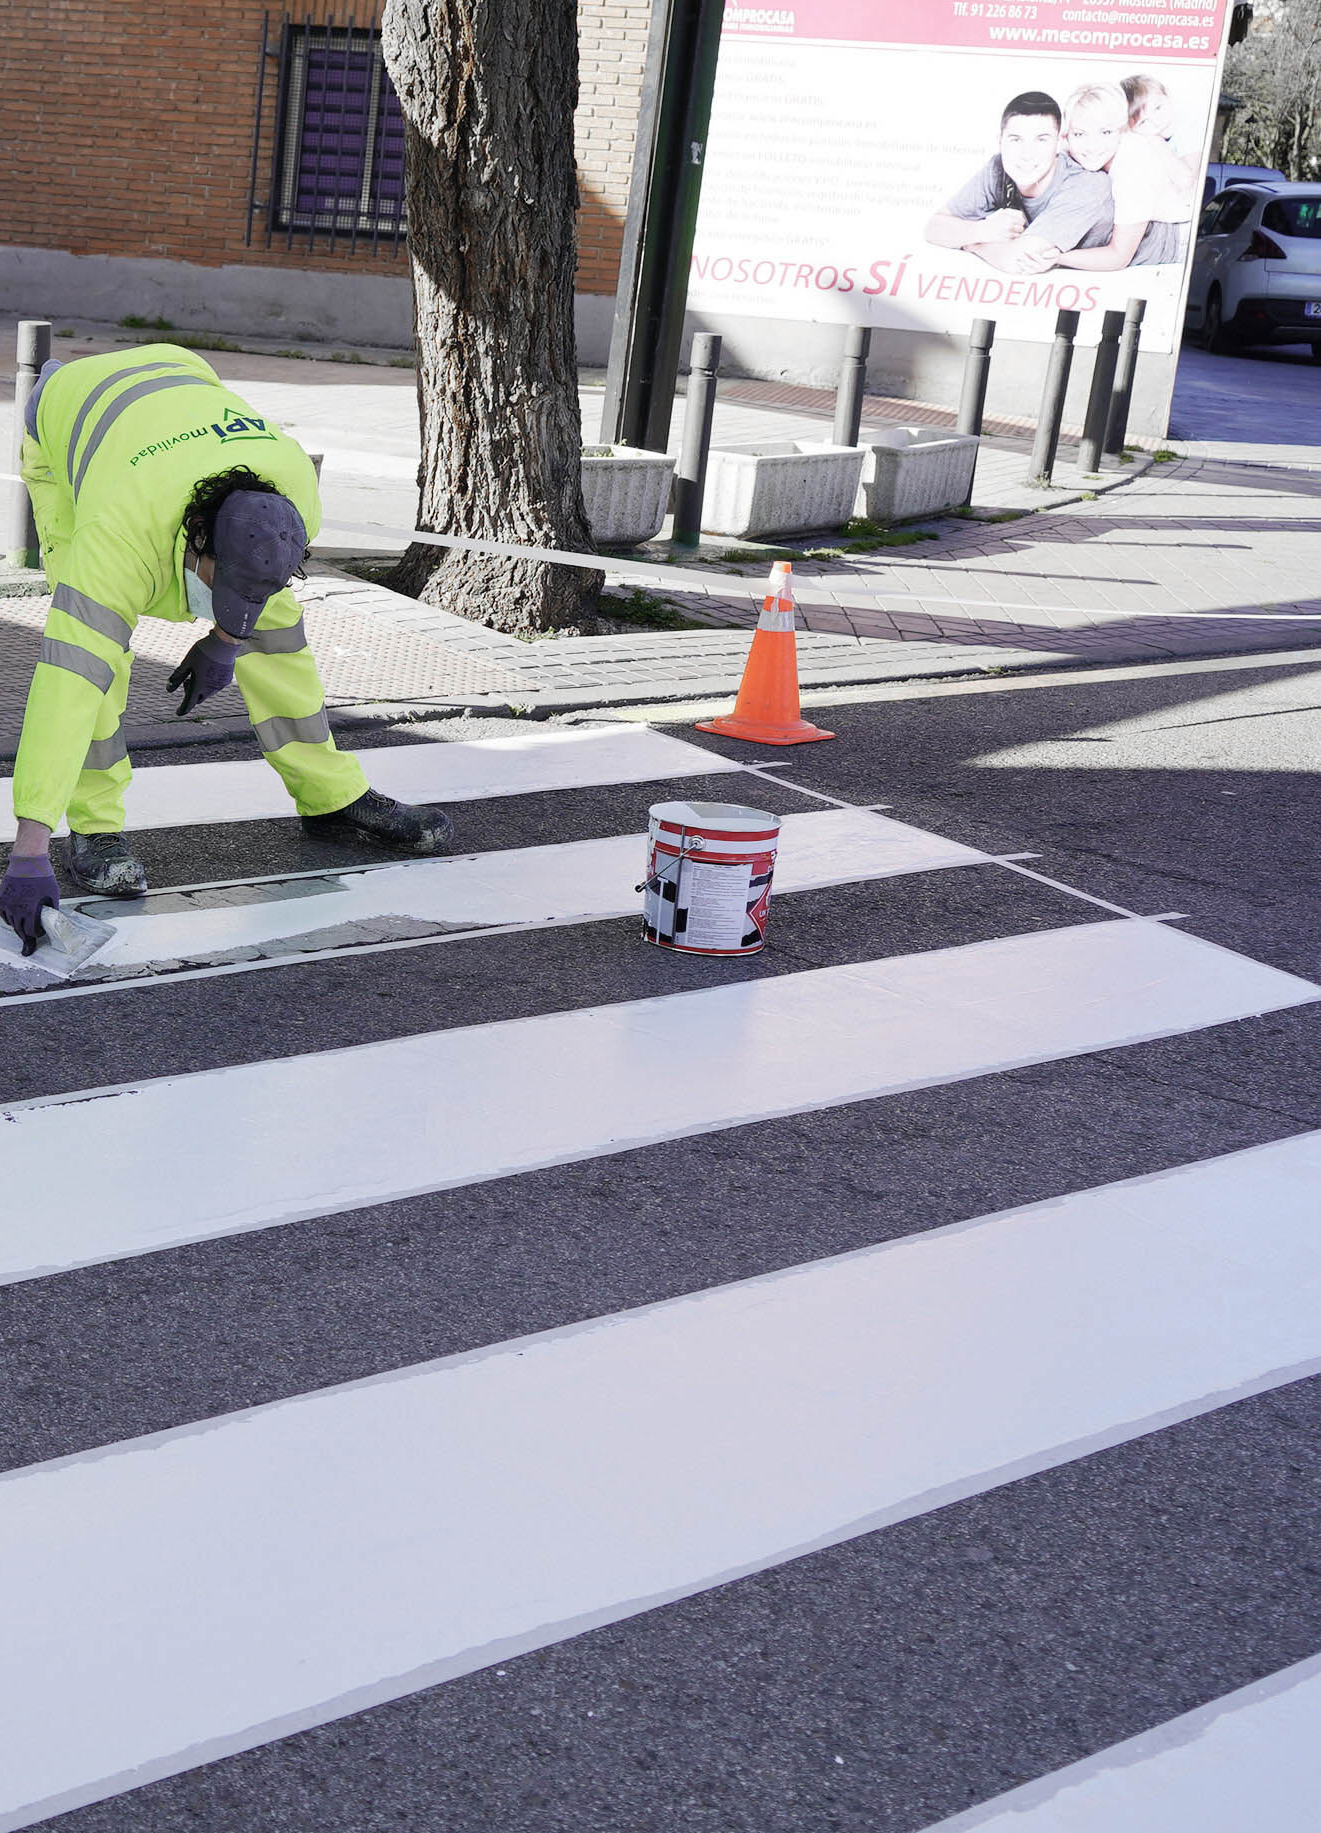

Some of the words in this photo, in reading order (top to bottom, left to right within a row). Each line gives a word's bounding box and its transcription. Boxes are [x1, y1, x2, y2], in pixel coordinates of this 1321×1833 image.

[970, 3, 984, 16] 91
[985, 4, 1006, 17] 226
[1007, 5, 1023, 18] 86
[1023, 6, 1038, 19] 73
[1062, 9, 1215, 27] contacto@mecomprocasa.es
[989, 26, 1210, 49] www.mecomprocasa.es
[691, 255, 857, 292] NOSOTROS
[862, 254, 913, 296] SÍ
[917, 273, 1101, 312] VENDEMOS
[211, 417, 266, 438] API
[130, 427, 208, 466] movilidad
